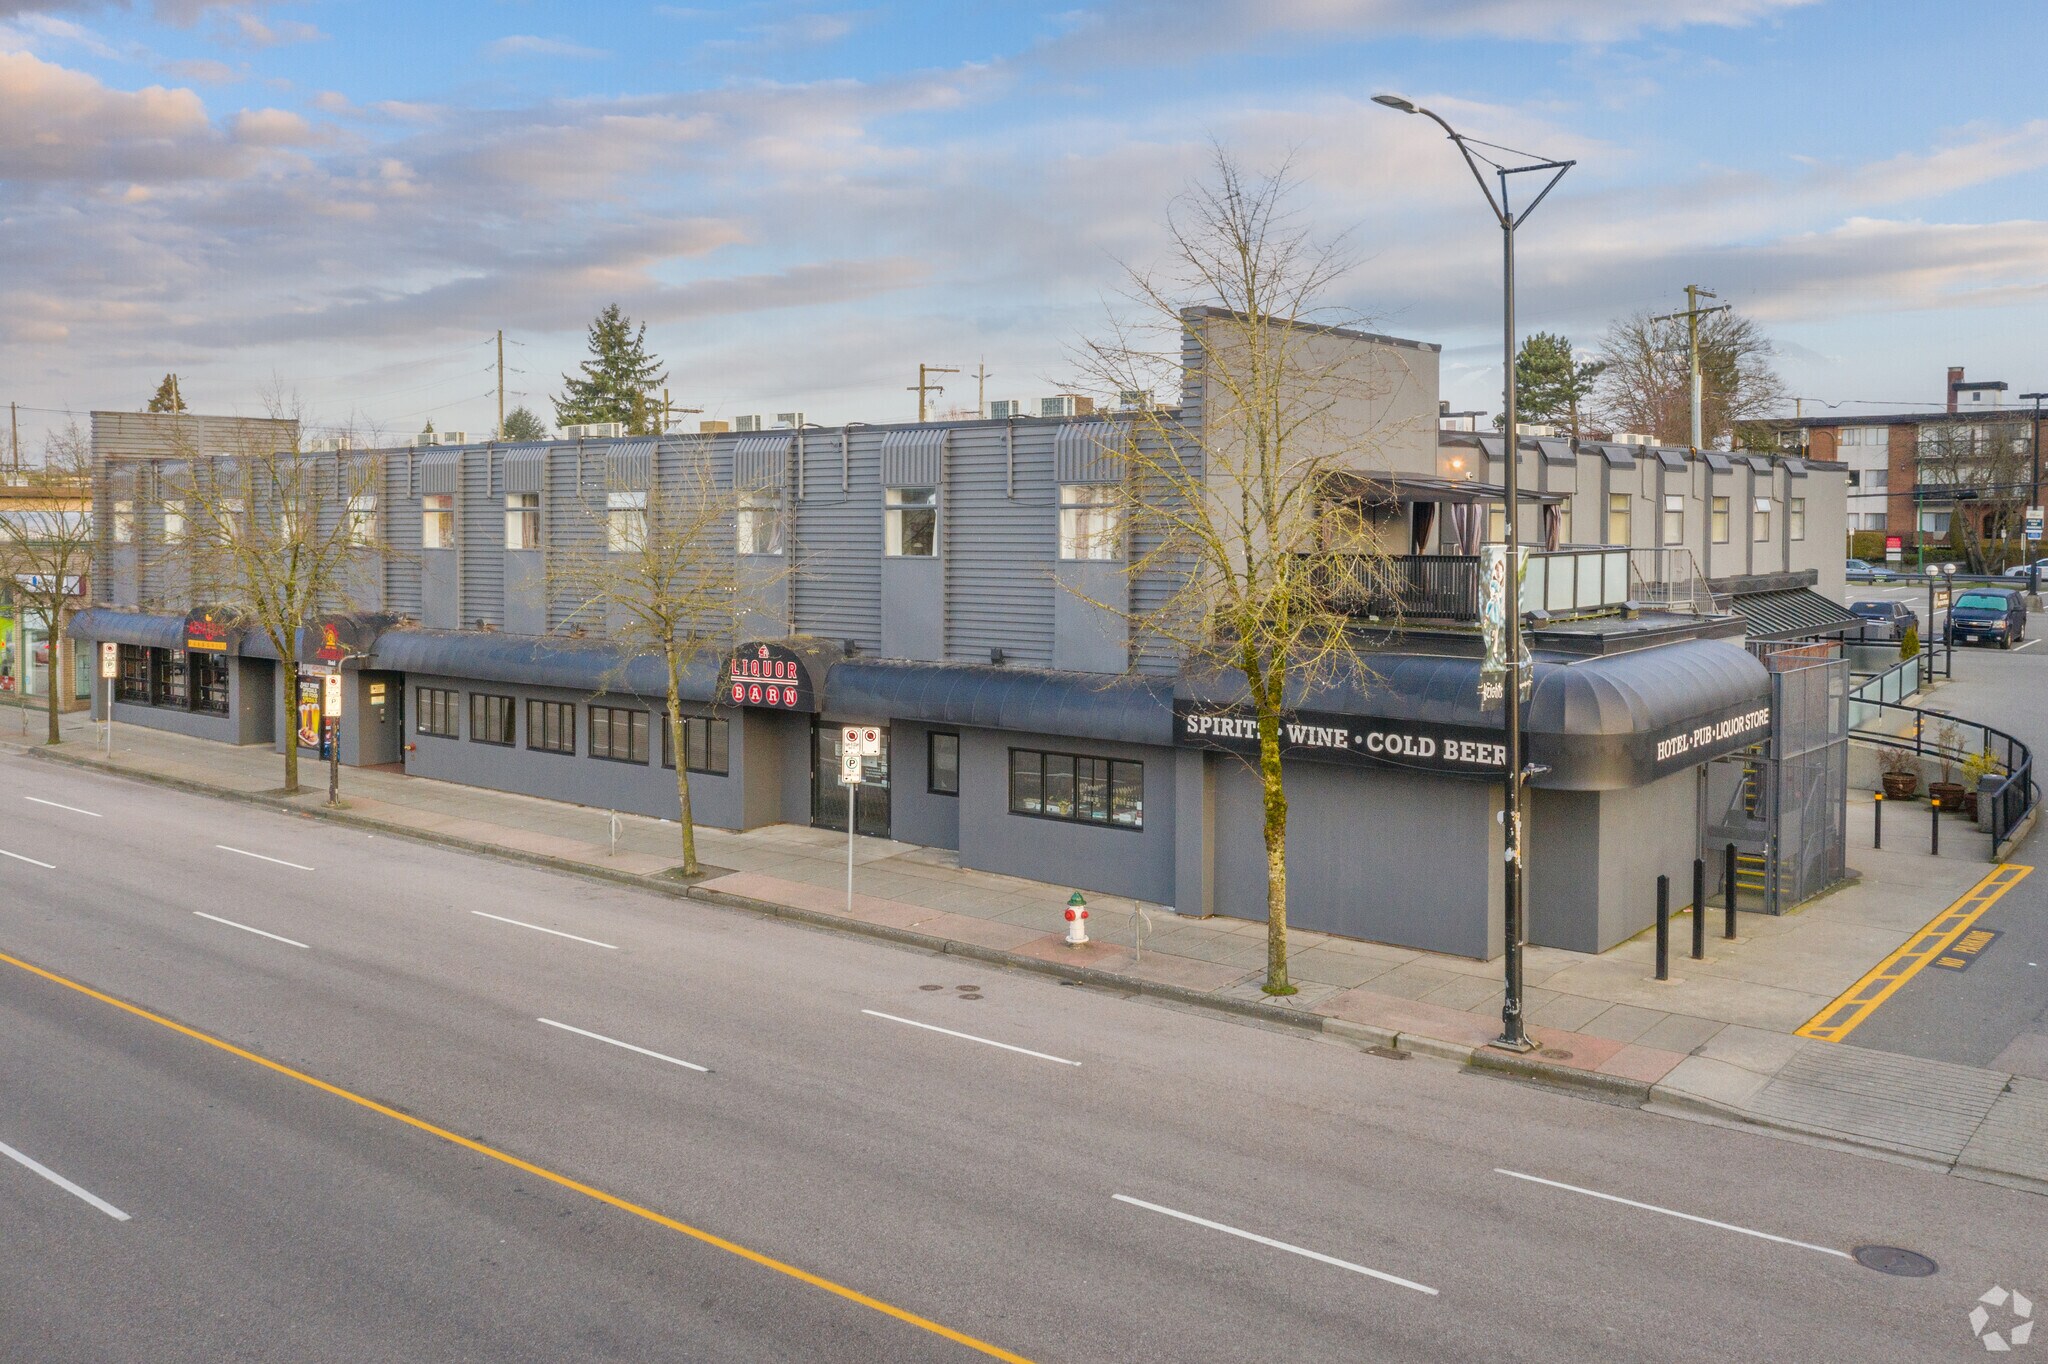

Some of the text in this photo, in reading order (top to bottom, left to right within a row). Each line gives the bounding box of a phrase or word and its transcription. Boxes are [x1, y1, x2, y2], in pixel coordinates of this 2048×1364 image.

[731, 658, 798, 679] LIQUOR
[733, 685, 797, 704] BARN
[1187, 714, 1506, 766] SPIRIT WINE COLD BEER
[1657, 707, 1769, 761] HOTEL PUB LIQUOR STORE
